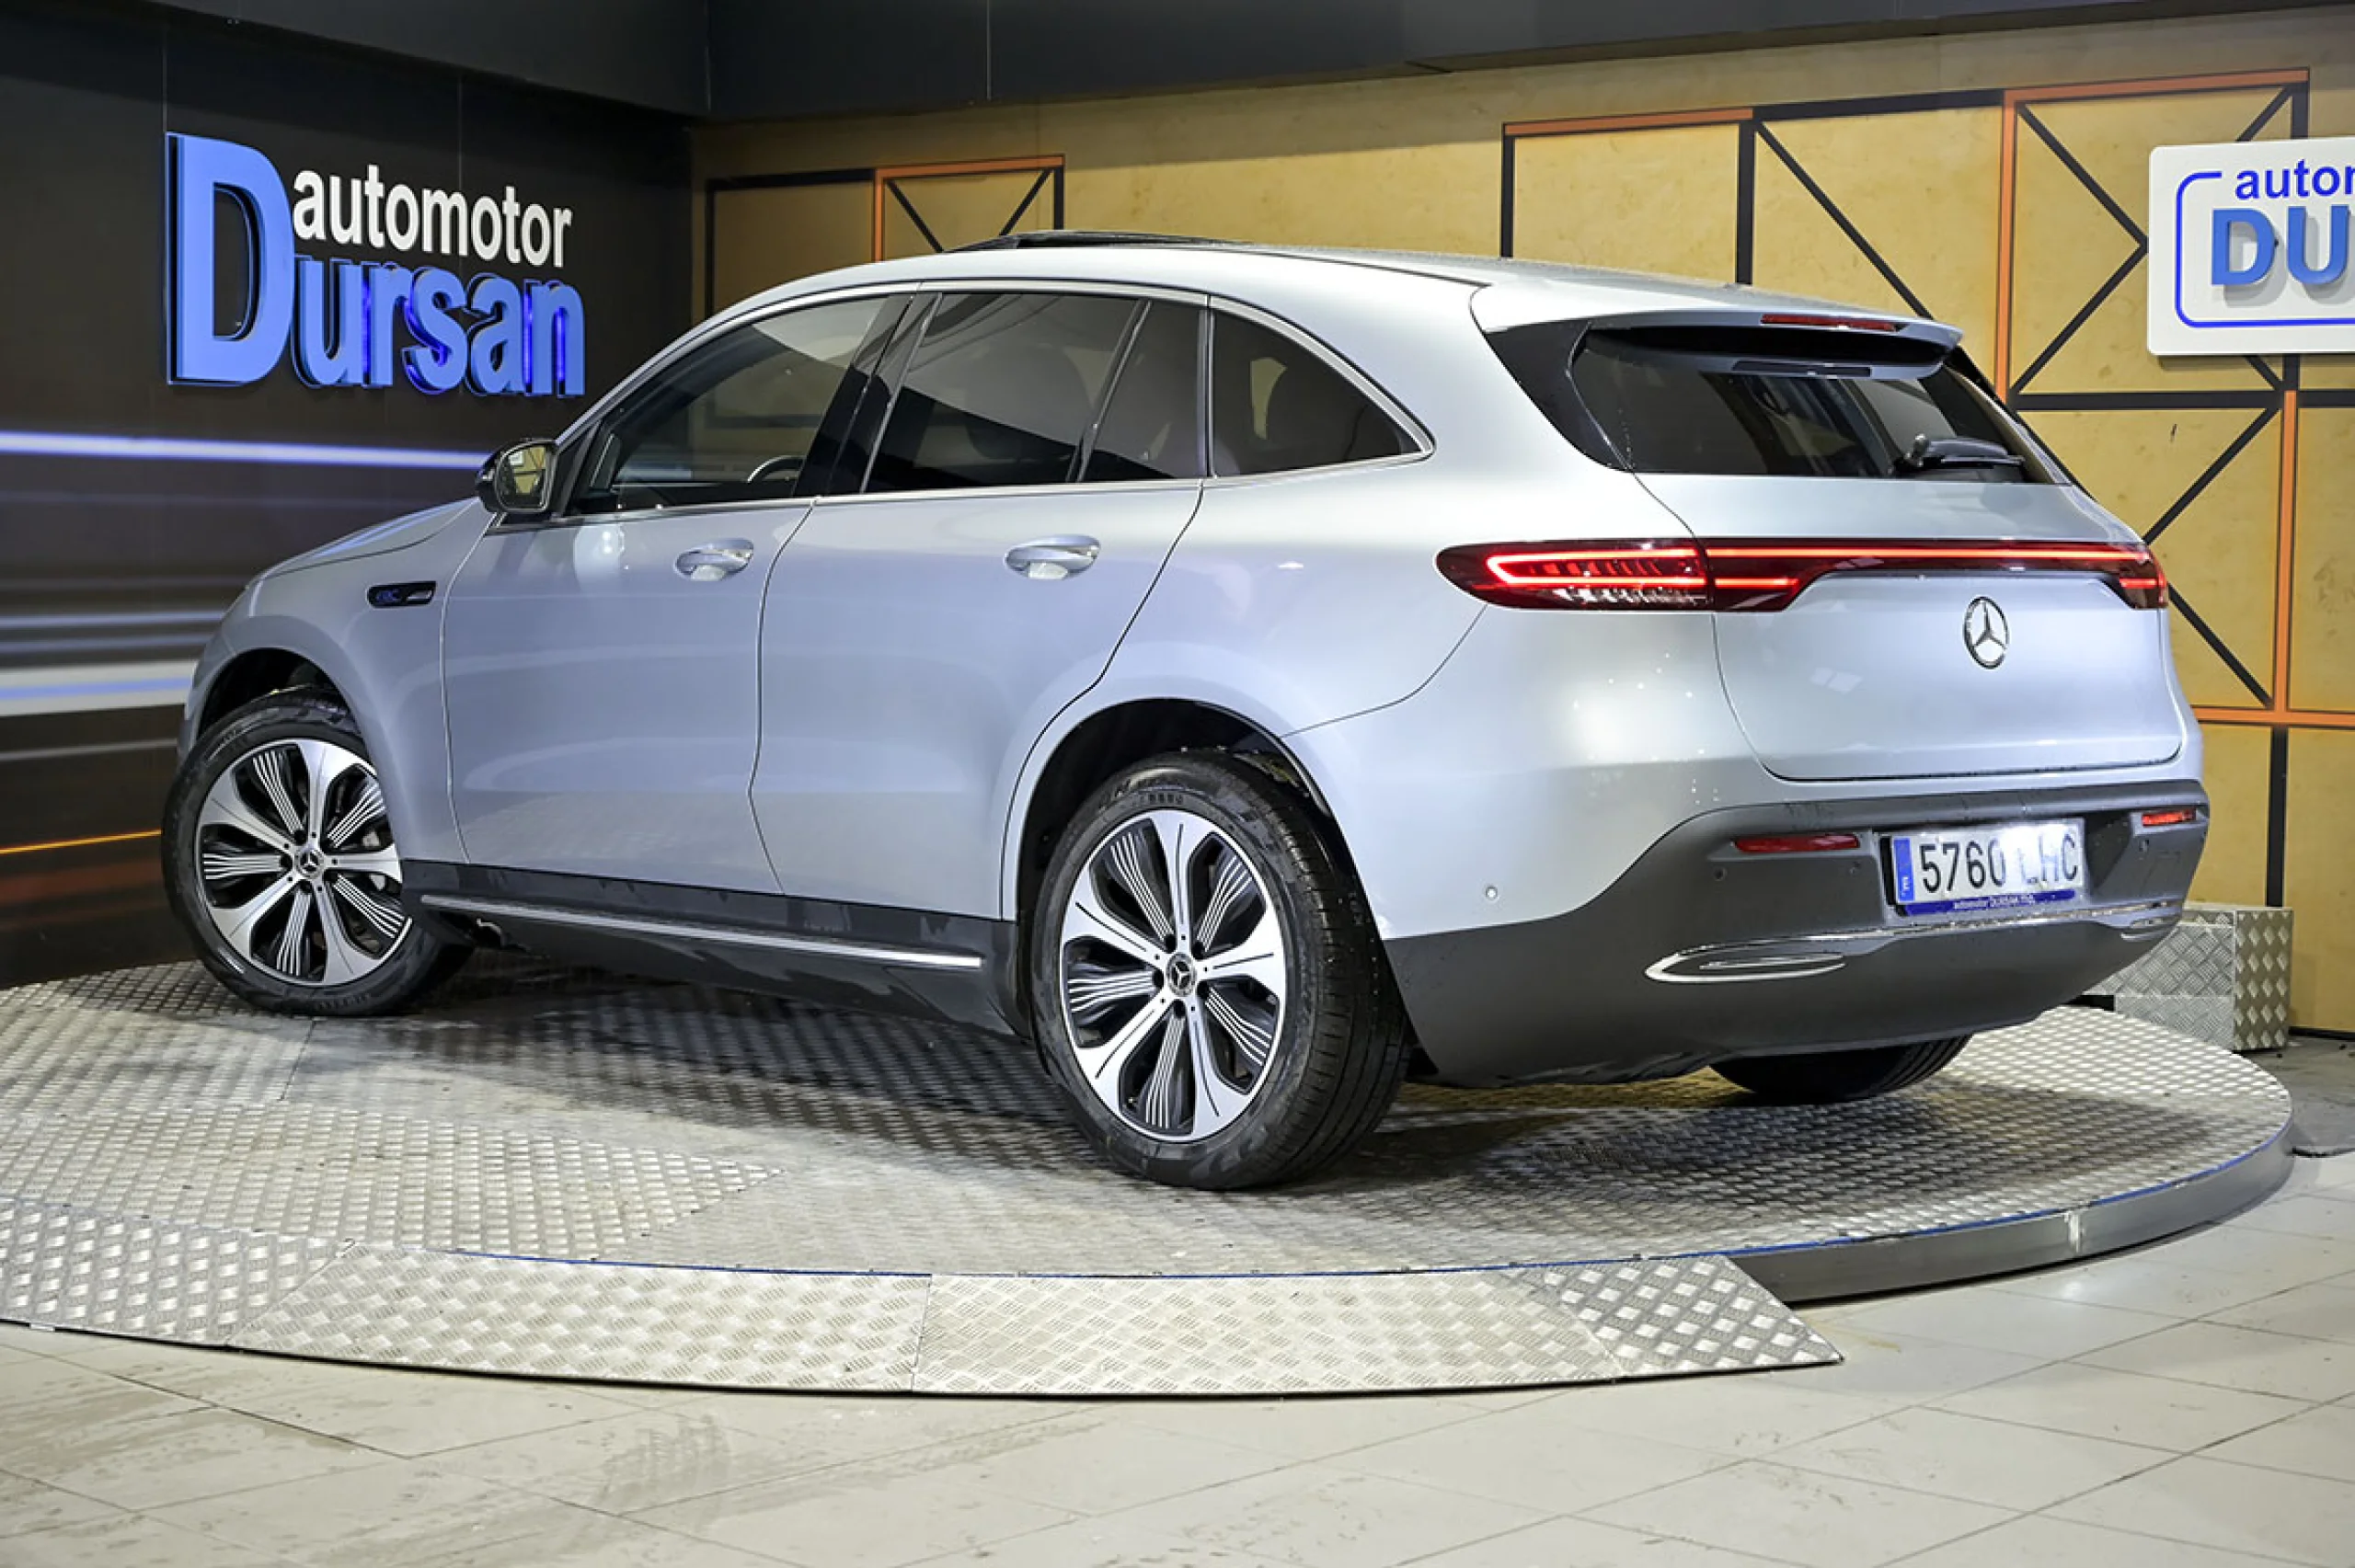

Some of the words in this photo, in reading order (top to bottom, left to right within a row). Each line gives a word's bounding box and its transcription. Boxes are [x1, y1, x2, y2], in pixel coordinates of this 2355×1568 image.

[167, 132, 585, 397] Dursan
[293, 164, 572, 268] automotor
[1919, 839, 2006, 892] 5760
